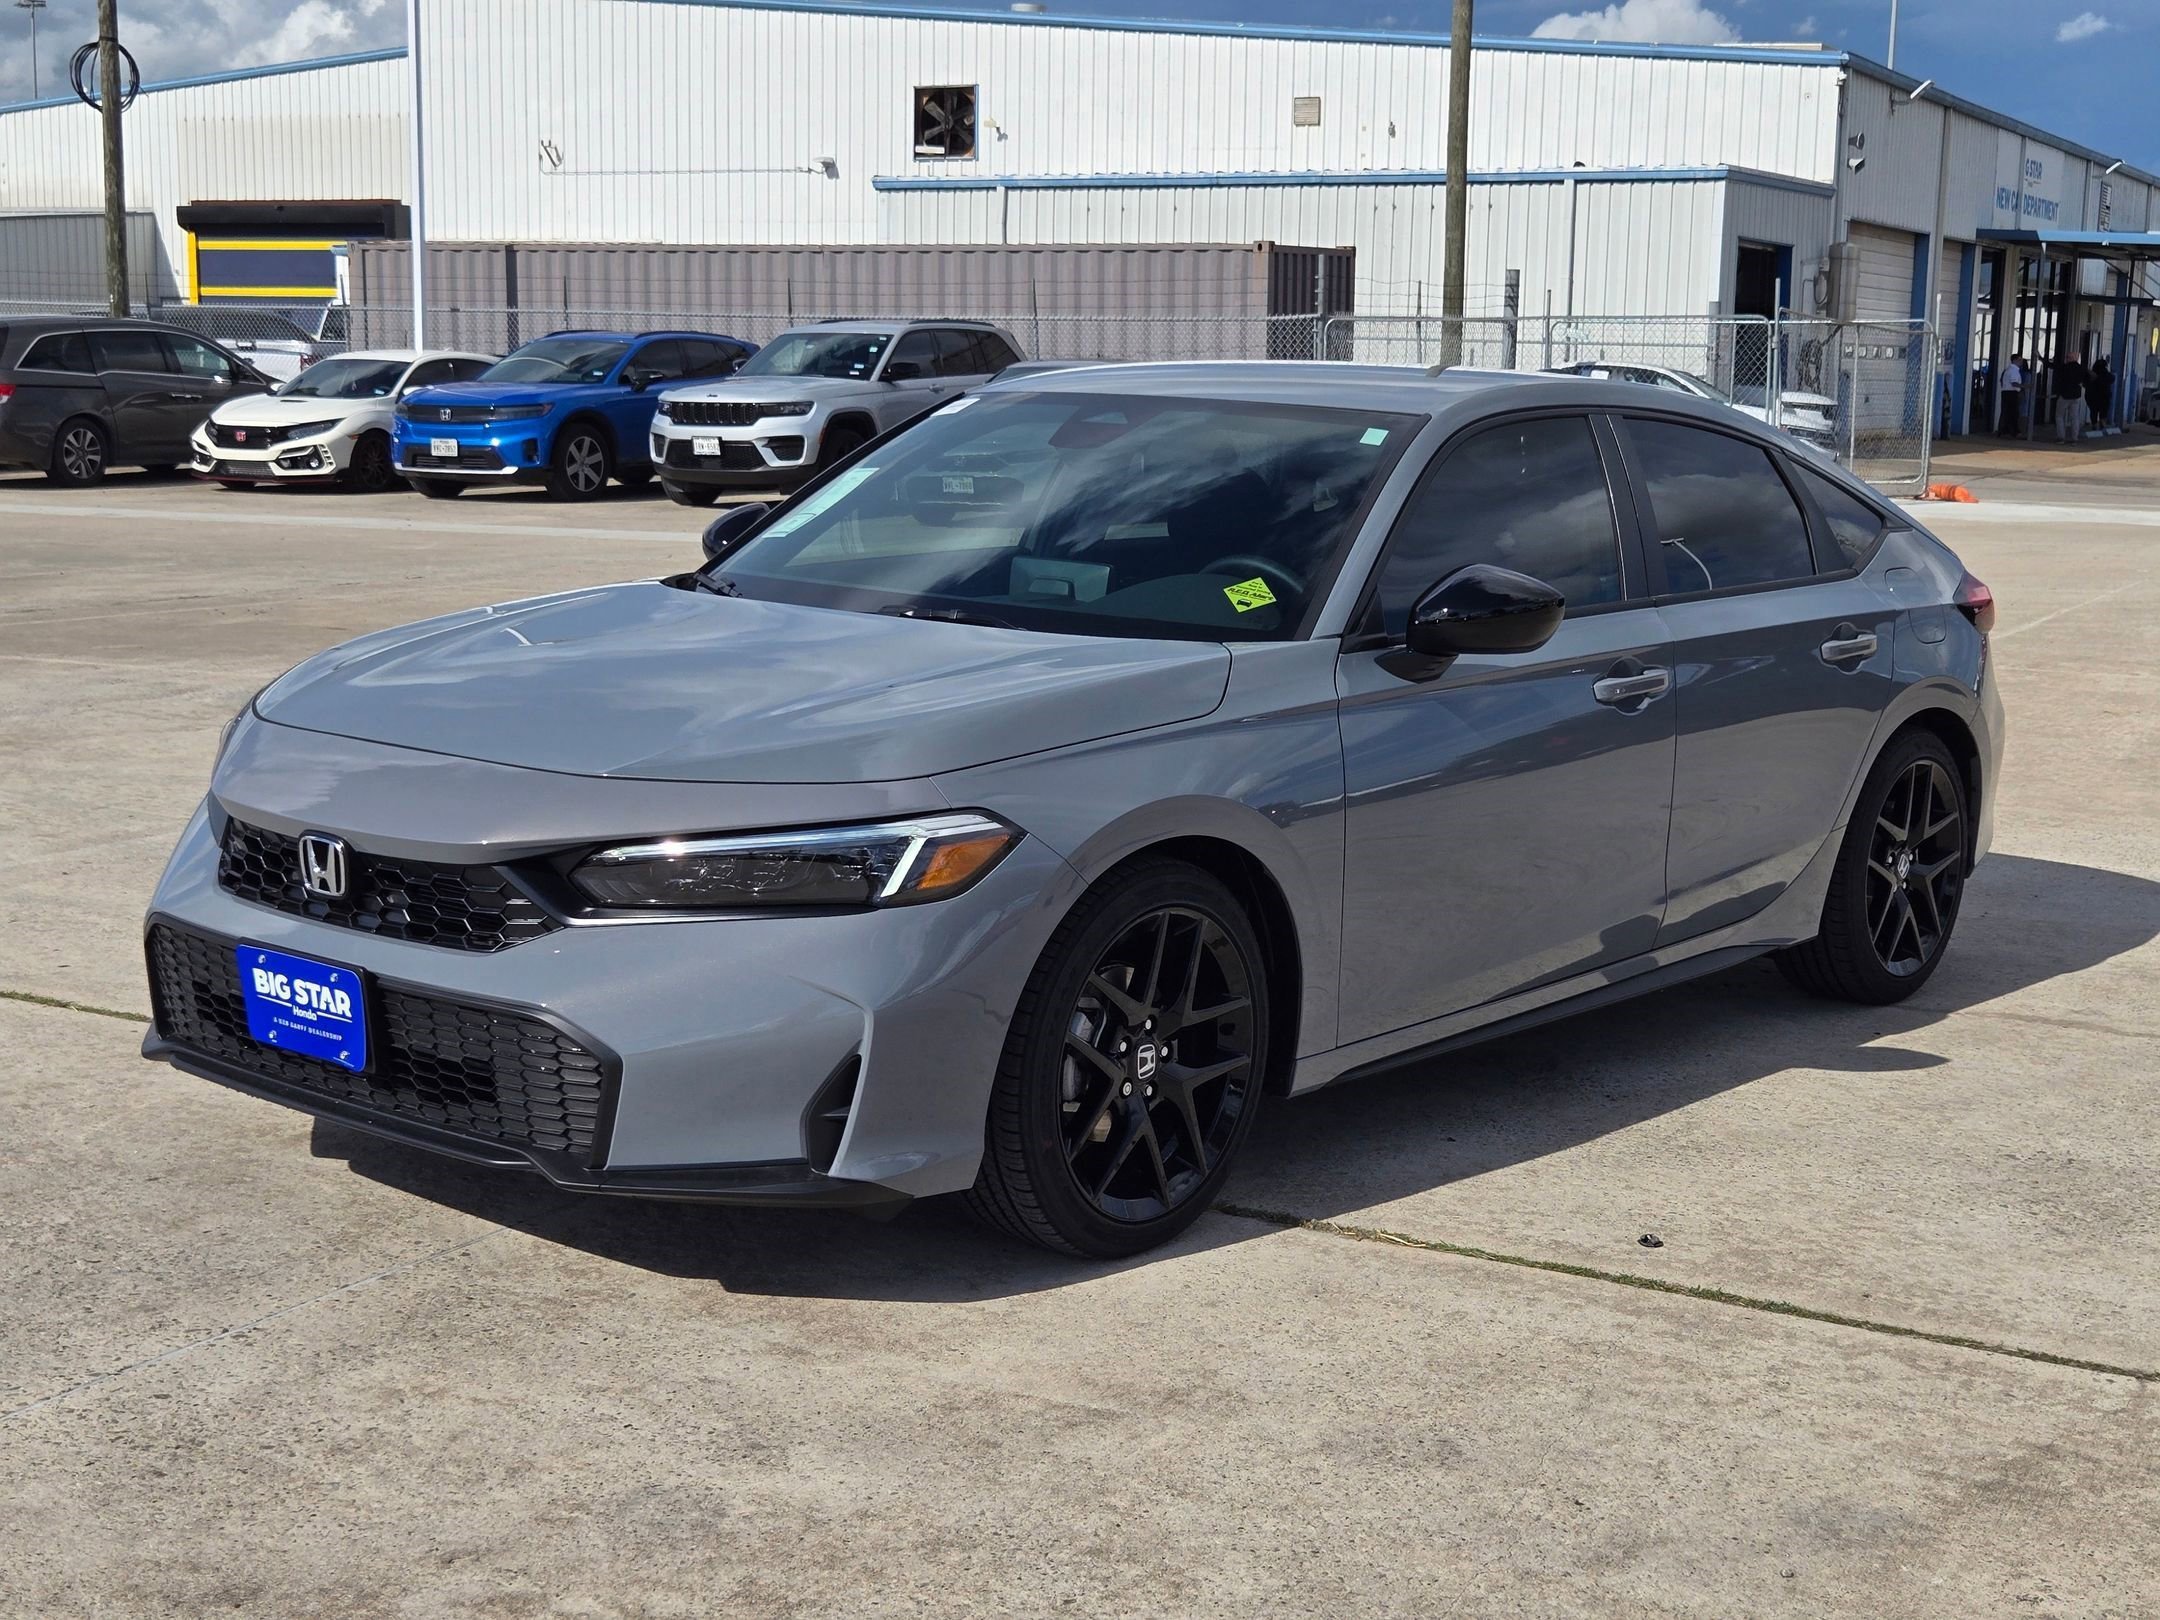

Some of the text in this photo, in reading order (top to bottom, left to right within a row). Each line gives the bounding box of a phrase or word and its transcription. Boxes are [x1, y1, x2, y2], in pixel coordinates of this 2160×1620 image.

[1996, 187, 2011, 211] NEW
[2023, 194, 2059, 222] DEPARTMENT
[252, 967, 353, 1018] BIG STAR
[292, 1005, 317, 1021] Honda
[308, 1026, 343, 1041] DEALERSHIP
